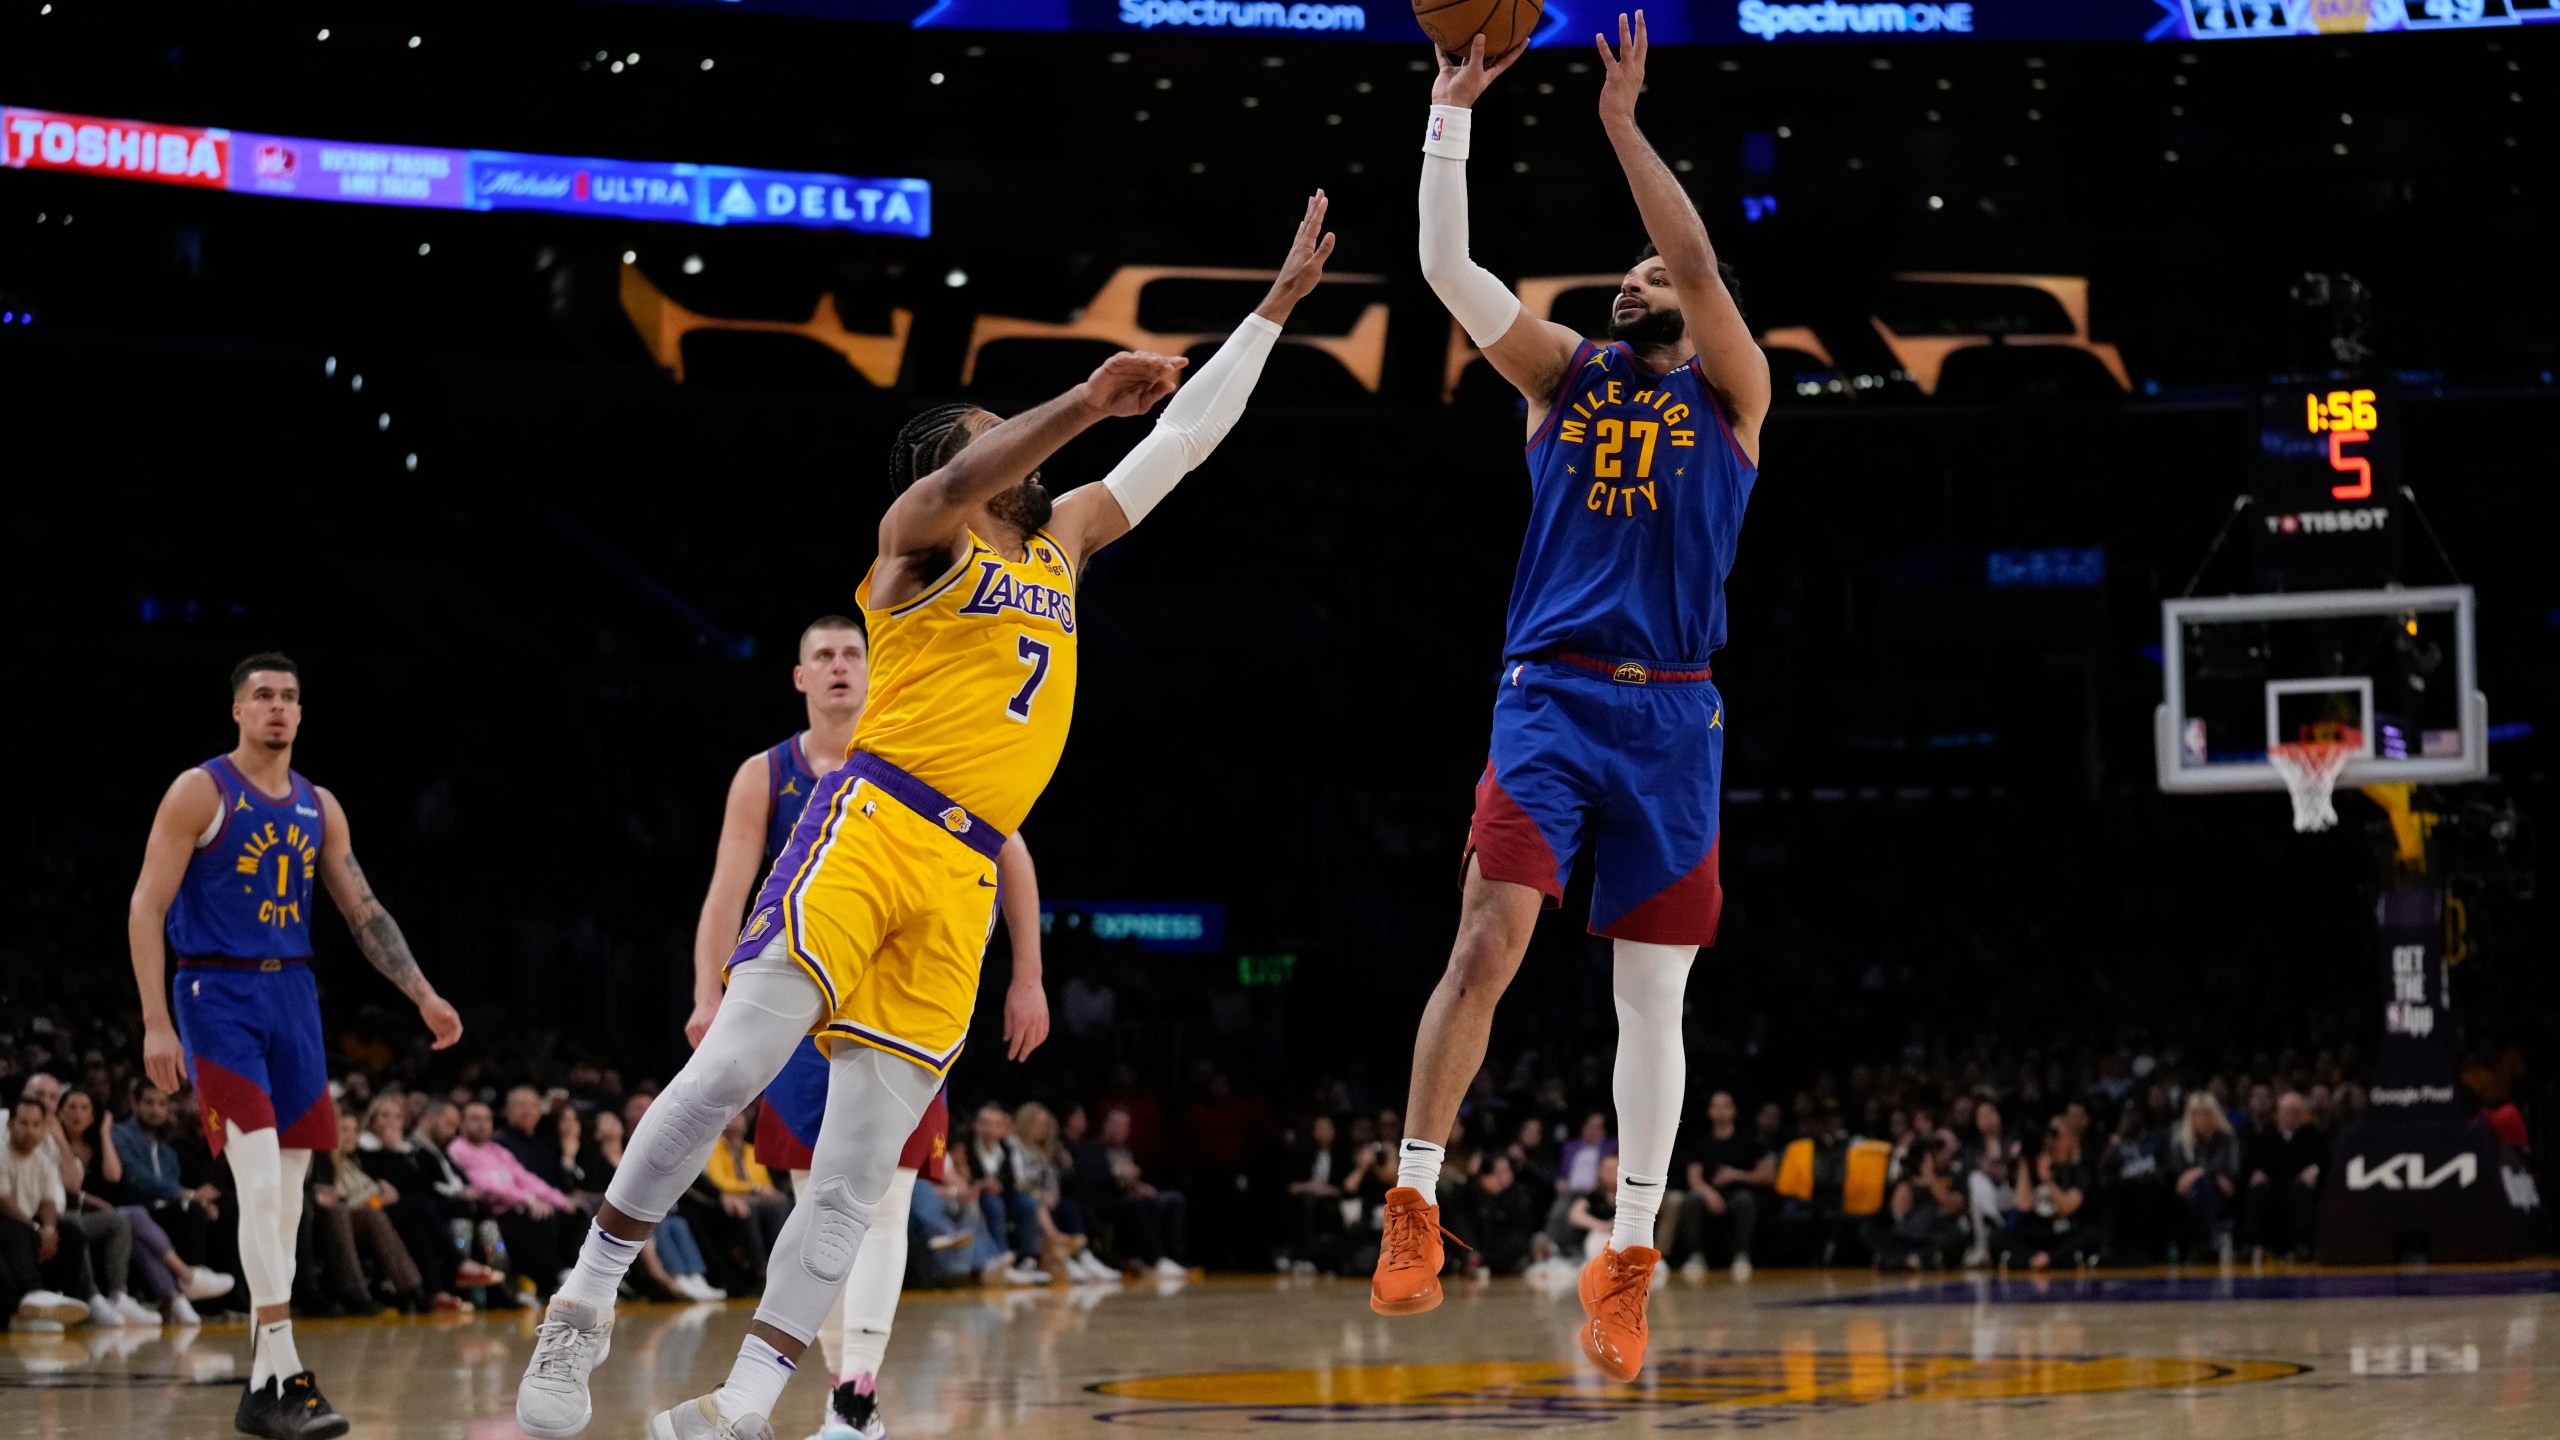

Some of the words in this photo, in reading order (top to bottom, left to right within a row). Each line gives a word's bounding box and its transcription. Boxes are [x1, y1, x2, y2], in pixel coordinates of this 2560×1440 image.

[1118, 0, 1366, 30] Spectrum.com
[11, 119, 222, 180] TOSHIBA
[591, 176, 690, 207] ULTRA
[765, 183, 914, 224] DELTA
[1560, 380, 1623, 444] MILE
[1633, 390, 1695, 447] HIGH
[2307, 389, 2378, 434] 1:56
[1594, 418, 1660, 479] 27
[2329, 430, 2372, 499] 5
[1586, 480, 1658, 517] CITY
[2298, 507, 2389, 535] TISSOT
[957, 560, 1075, 635] LAKERS
[1005, 632, 1052, 725] 7
[236, 822, 280, 875] MILE
[286, 823, 317, 879] HIGH
[276, 854, 290, 897] 1
[258, 899, 301, 929] CITY
